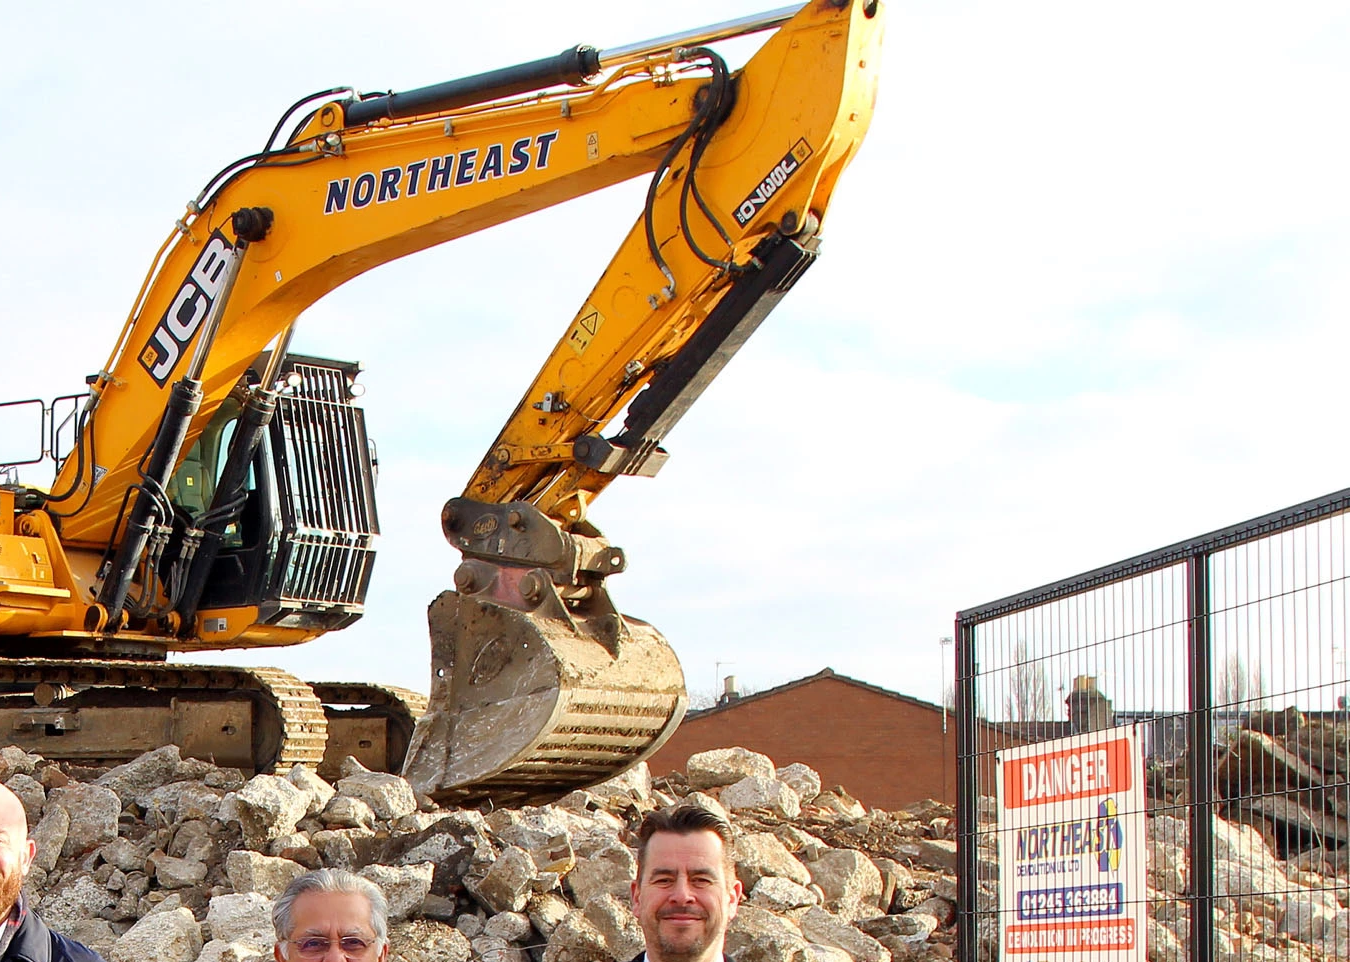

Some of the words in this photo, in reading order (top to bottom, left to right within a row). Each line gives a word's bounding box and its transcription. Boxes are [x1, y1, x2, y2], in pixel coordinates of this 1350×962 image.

[324, 129, 560, 215] NORTHEAST
[151, 237, 234, 381] JCB
[1022, 749, 1110, 801] DANGER
[1016, 816, 1117, 861] NORTHEAST
[1016, 861, 1056, 877] DEMOLITION
[1068, 859, 1080, 872] LTD
[1022, 893, 1063, 916] 01245
[1065, 887, 1117, 914] 363884
[1008, 928, 1064, 949] DEMOLITION
[1080, 925, 1133, 946] PROGRESS
